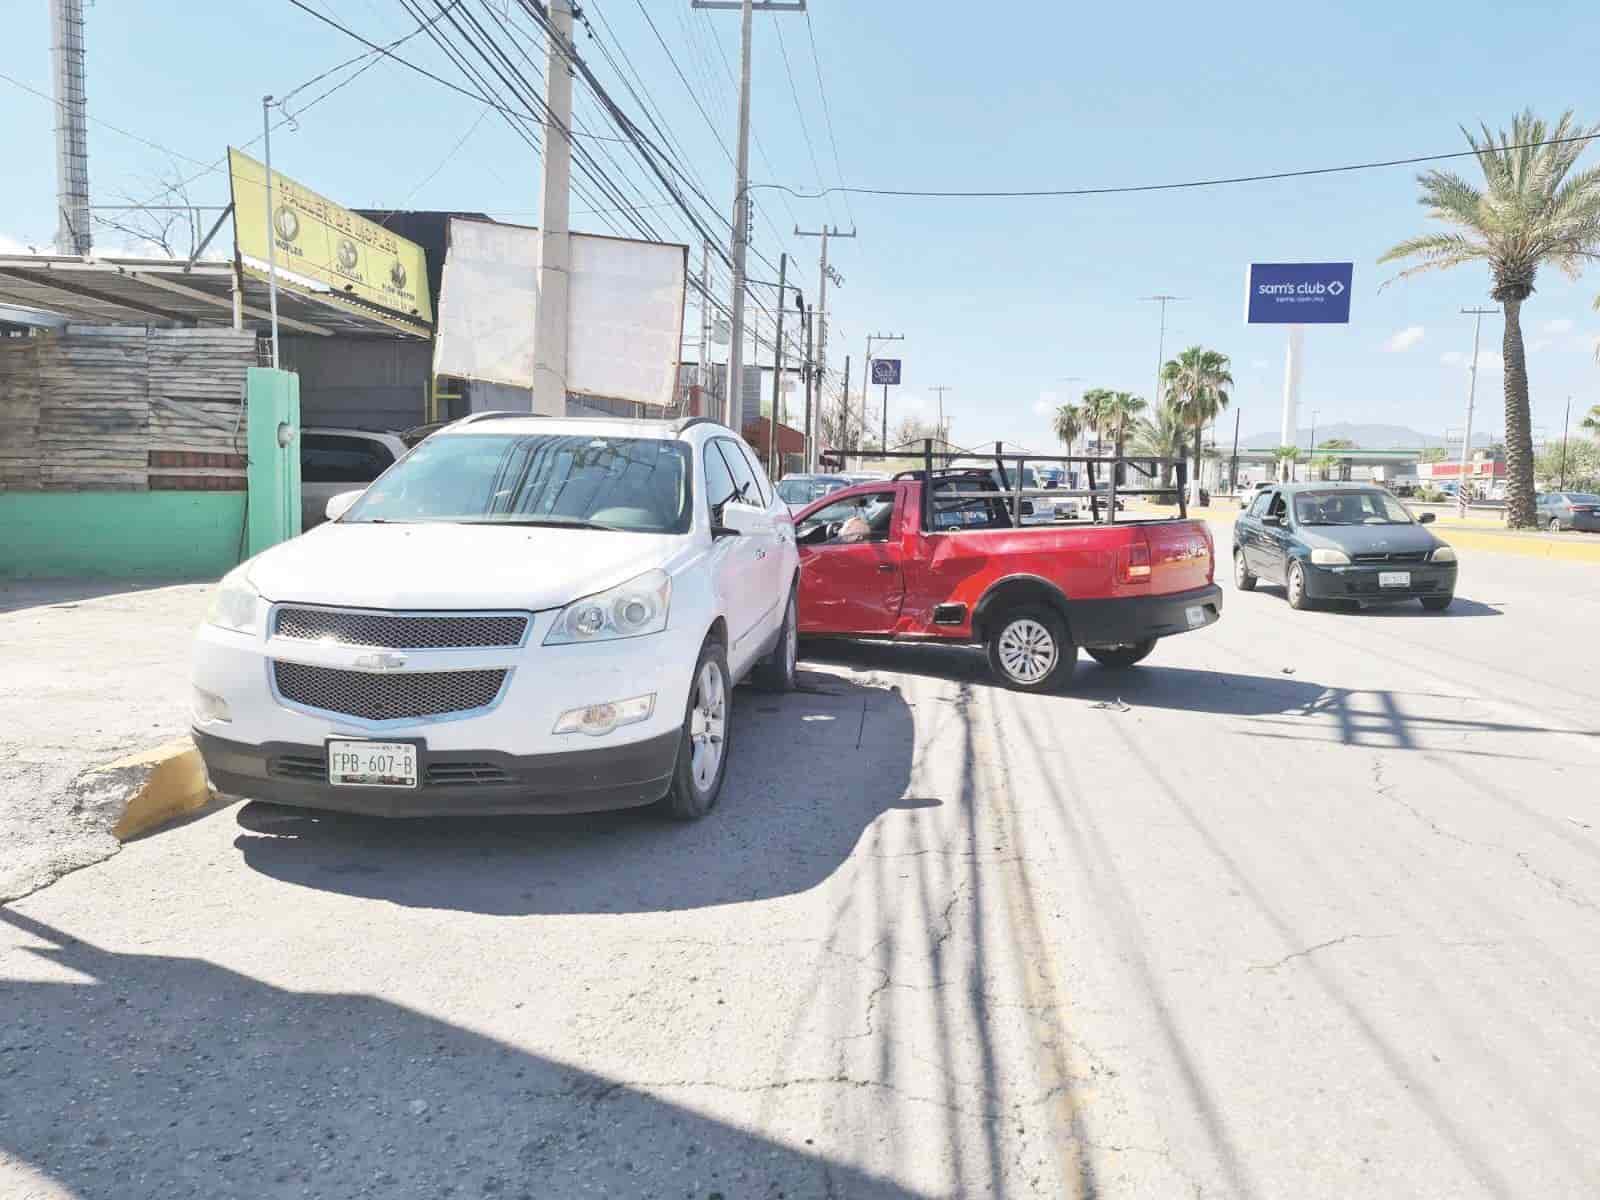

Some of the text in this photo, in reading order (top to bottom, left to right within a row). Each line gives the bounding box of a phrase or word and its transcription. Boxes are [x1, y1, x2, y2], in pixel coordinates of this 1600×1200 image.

[1259, 281, 1325, 294] sam's club
[333, 753, 412, 775] FPB-607-B
